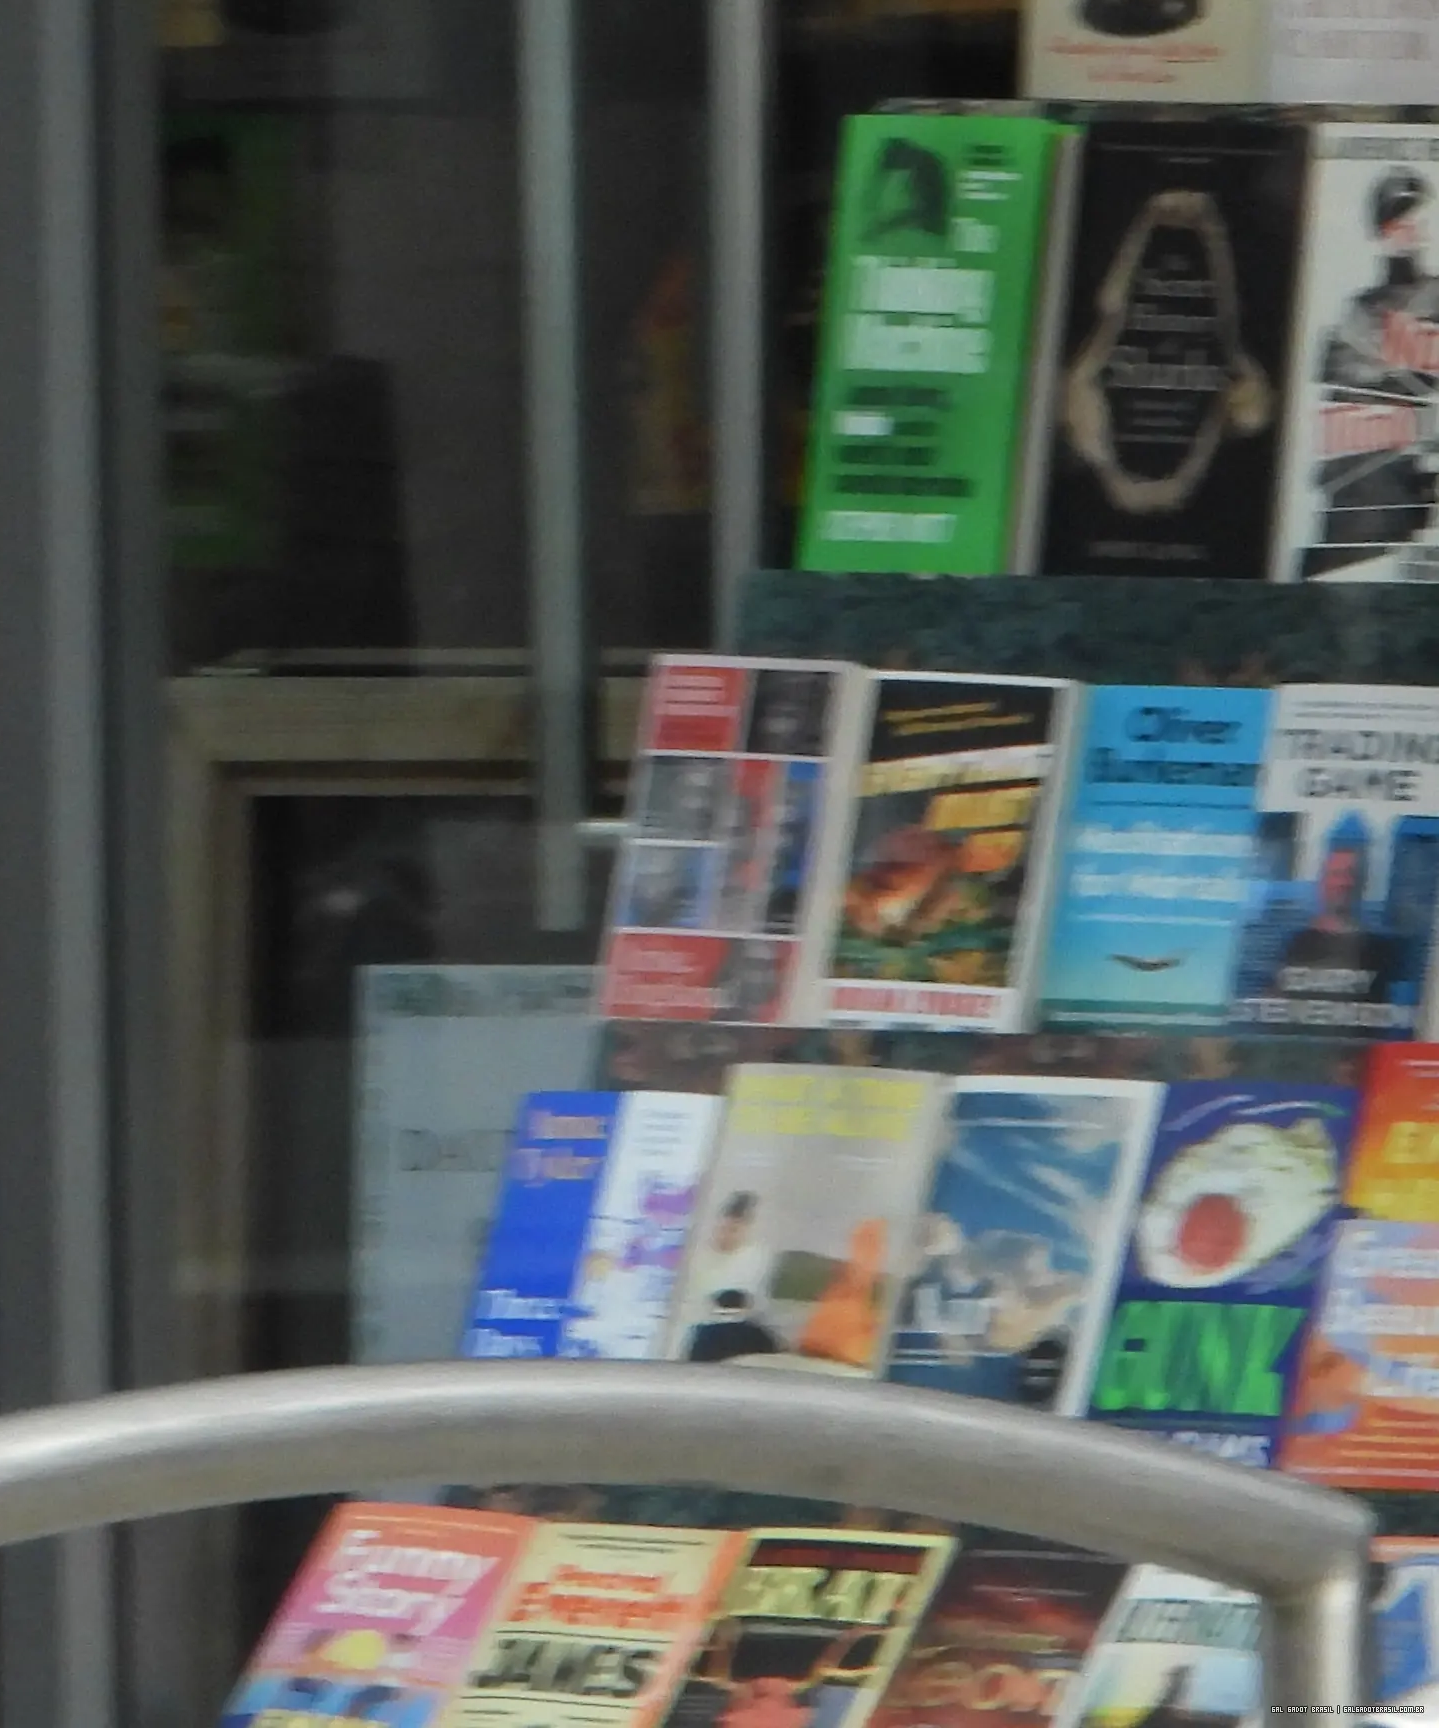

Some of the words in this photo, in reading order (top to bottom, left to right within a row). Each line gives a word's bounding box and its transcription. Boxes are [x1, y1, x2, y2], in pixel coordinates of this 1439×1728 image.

[1298, 767, 1424, 802] GAME
[335, 1530, 499, 1600] Funny
[317, 1568, 459, 1634] Story
[471, 1638, 661, 1700] JAMES
